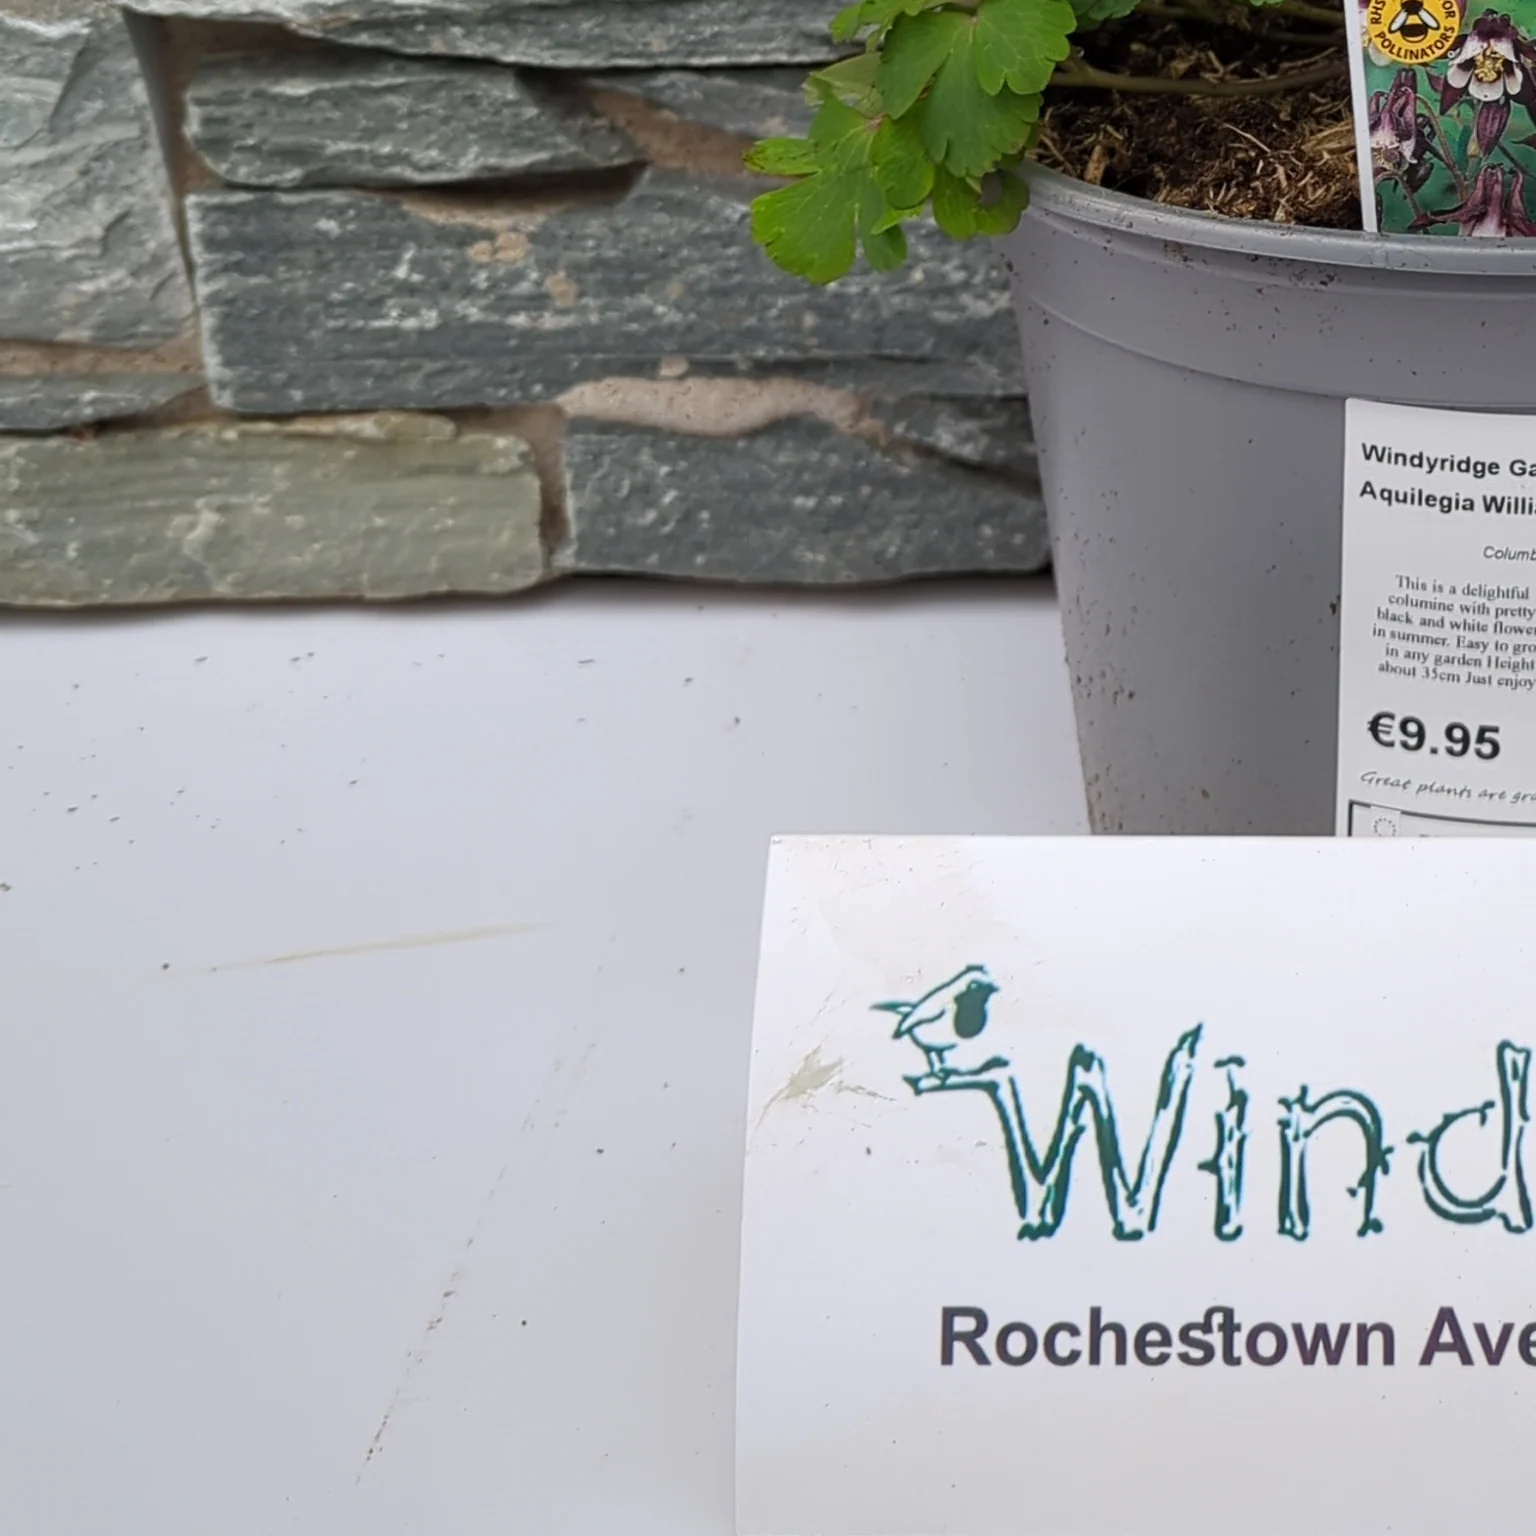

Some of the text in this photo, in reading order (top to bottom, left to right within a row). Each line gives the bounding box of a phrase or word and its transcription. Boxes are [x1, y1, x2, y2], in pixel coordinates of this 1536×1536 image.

[1374, 25, 1455, 61] POLLINATORS
[1361, 442, 1501, 479] Windyridge
[1359, 480, 1476, 514] Aquilegia
[1396, 574, 1529, 601] This is a delightful
[1377, 606, 1413, 625] black
[1419, 616, 1445, 629] and
[1450, 618, 1488, 634] white
[1388, 593, 1536, 621] columine with pretty
[1372, 623, 1386, 638] in
[1456, 635, 1489, 653] Easy
[1495, 640, 1508, 652] to
[1385, 643, 1535, 673] in any garden Height
[1378, 660, 1536, 691] about 35cm Just enjoy
[1367, 711, 1501, 761] €9.95
[1360, 770, 1412, 790] Great
[1416, 780, 1472, 801] plants
[1478, 787, 1507, 800] are
[940, 1305, 1396, 1368] Rochestown
